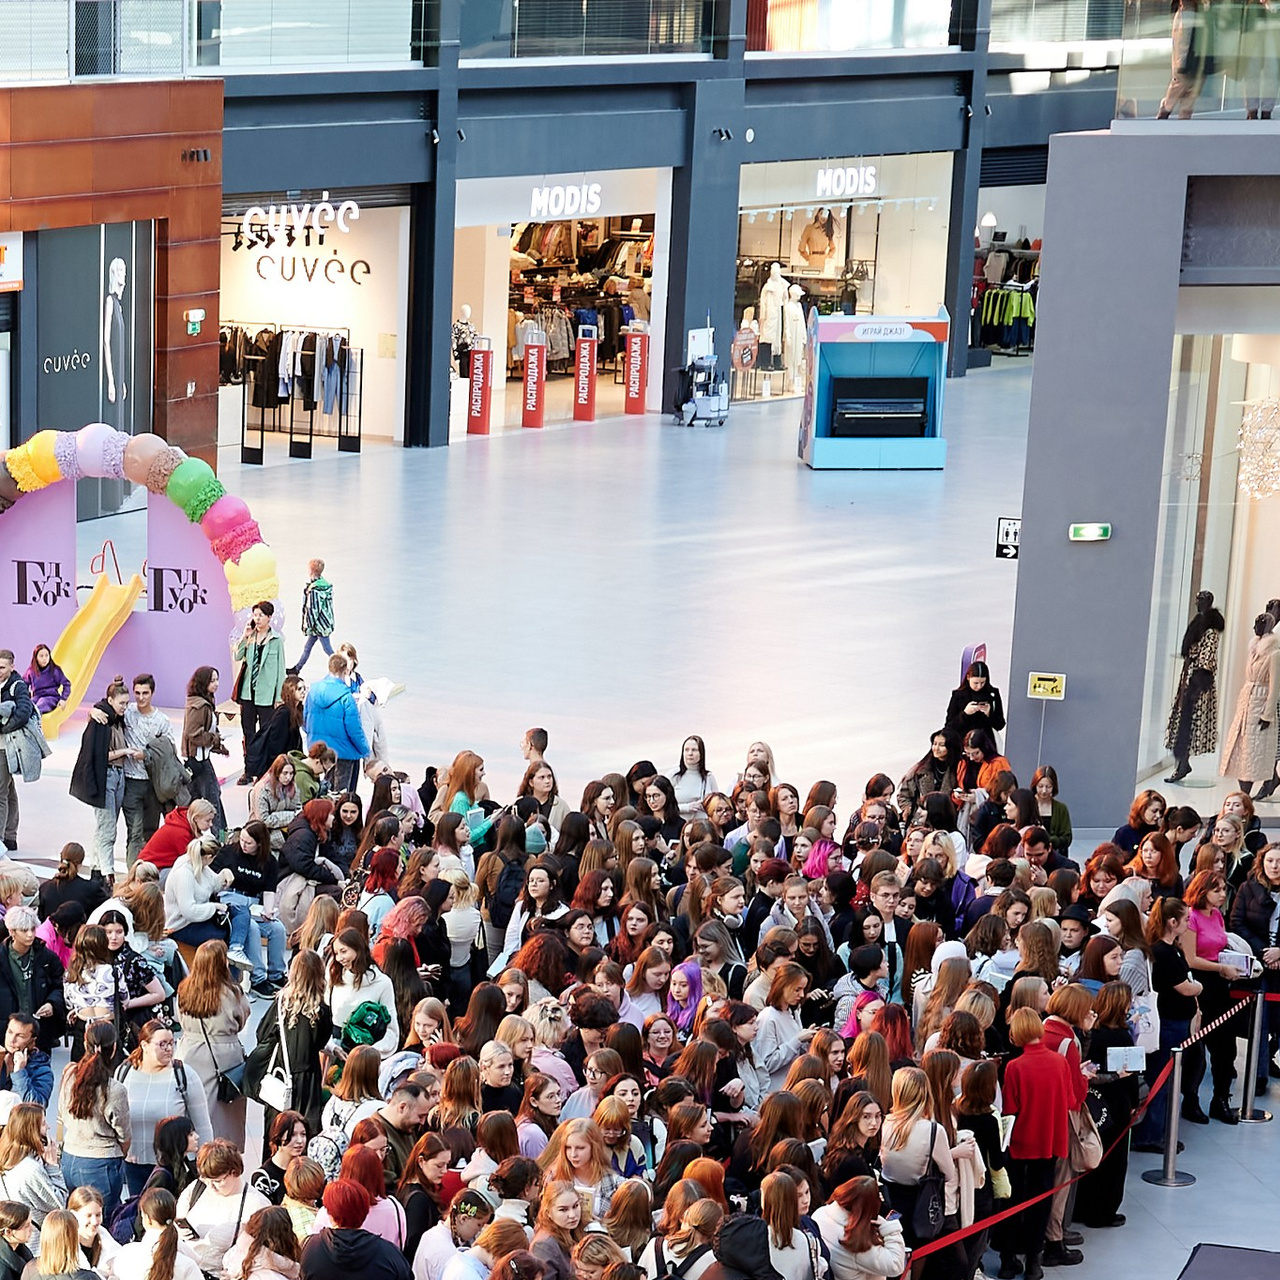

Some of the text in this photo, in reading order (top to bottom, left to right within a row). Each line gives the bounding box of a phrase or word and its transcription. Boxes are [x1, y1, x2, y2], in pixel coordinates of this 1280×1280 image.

[530, 183, 602, 218] MODIS
[816, 165, 877, 197] MODIS
[862, 327, 905, 336] ИГРАЙ ДЖАЗ!
[471, 353, 484, 417] РАСПРОДАЖА
[526, 348, 539, 411] РАСПРОДАЖА
[578, 342, 591, 404] РАСПРОДАЖА
[629, 337, 642, 398] РАСПРОДАЖА
